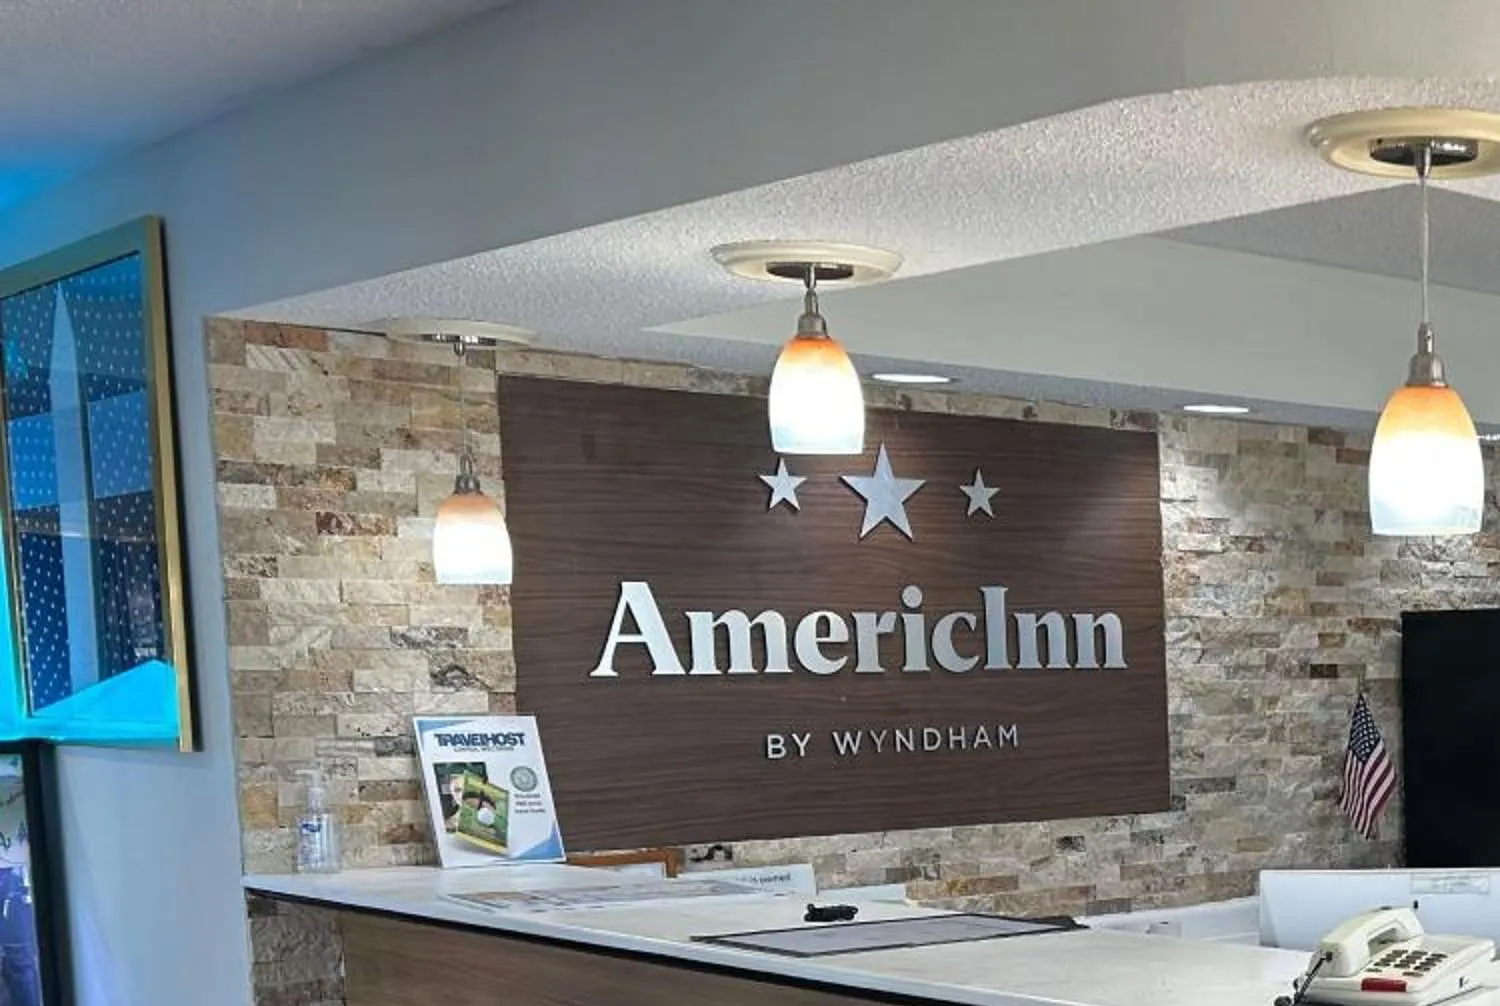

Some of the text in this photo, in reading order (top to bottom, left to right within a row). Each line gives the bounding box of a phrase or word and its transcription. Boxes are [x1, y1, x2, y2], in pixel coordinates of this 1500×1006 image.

[589, 580, 1128, 678] AmericInn
[765, 723, 1021, 761] BY WYNDHAM
